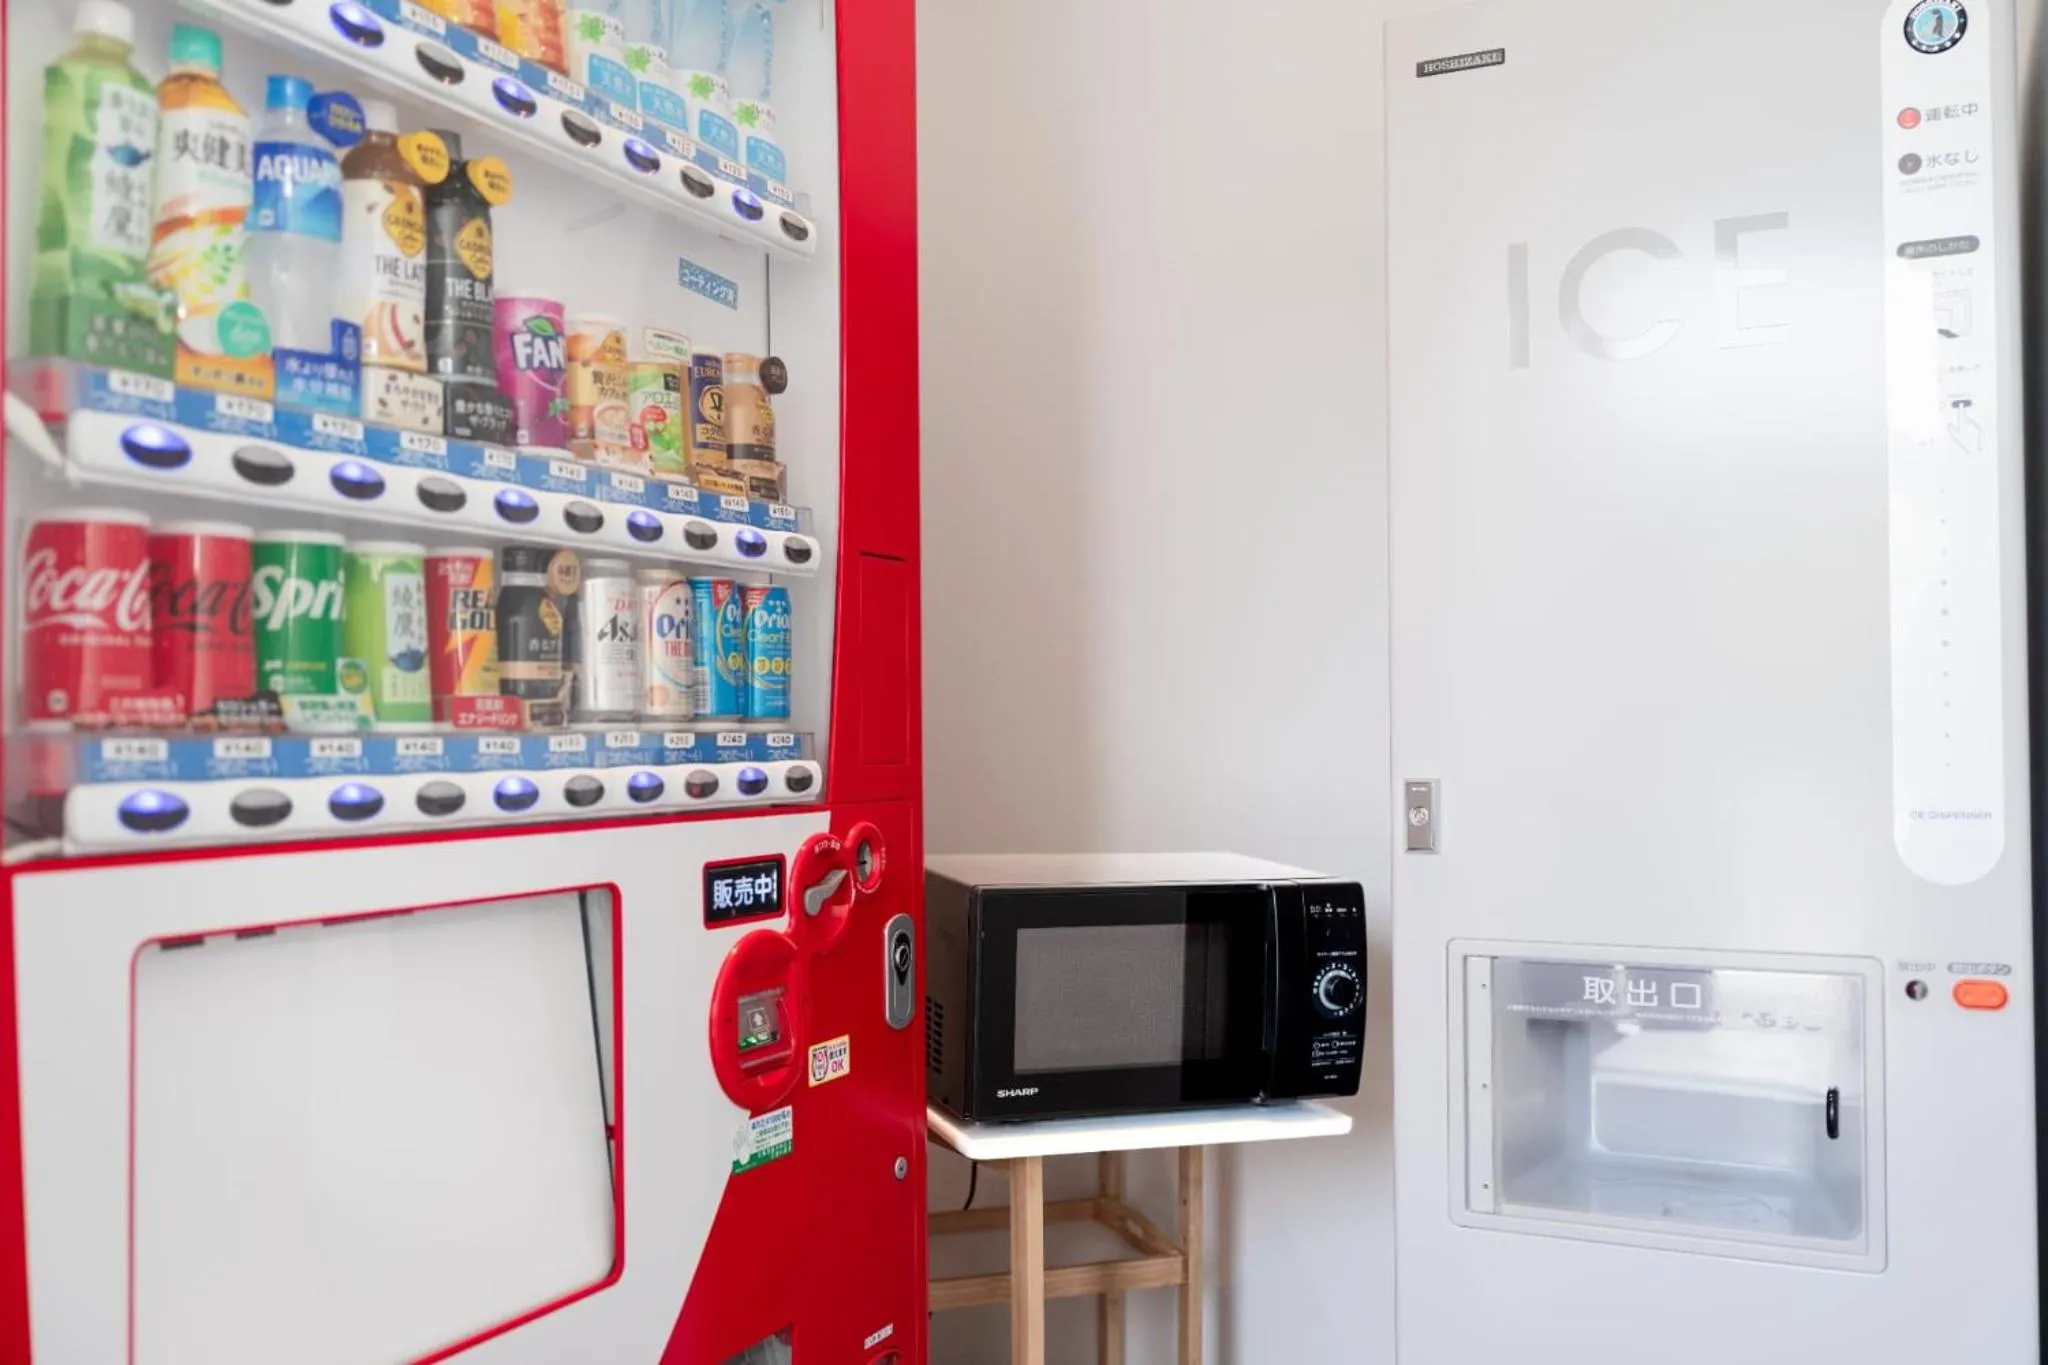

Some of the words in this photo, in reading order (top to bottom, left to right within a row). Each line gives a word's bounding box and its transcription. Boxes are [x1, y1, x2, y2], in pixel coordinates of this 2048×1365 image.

[1926, 150, 1979, 168] 氷なし
[375, 255, 400, 278] THE
[445, 277, 471, 298] THE
[1507, 211, 1790, 370] ICE
[642, 391, 675, 405] アロエ
[408, 436, 441, 452] ¥170
[404, 740, 437, 752] ¥140
[485, 739, 516, 751] ¥140
[1583, 975, 1702, 1009] 取出口
[831, 1059, 844, 1073] OK
[996, 1086, 1039, 1099] SHARP
